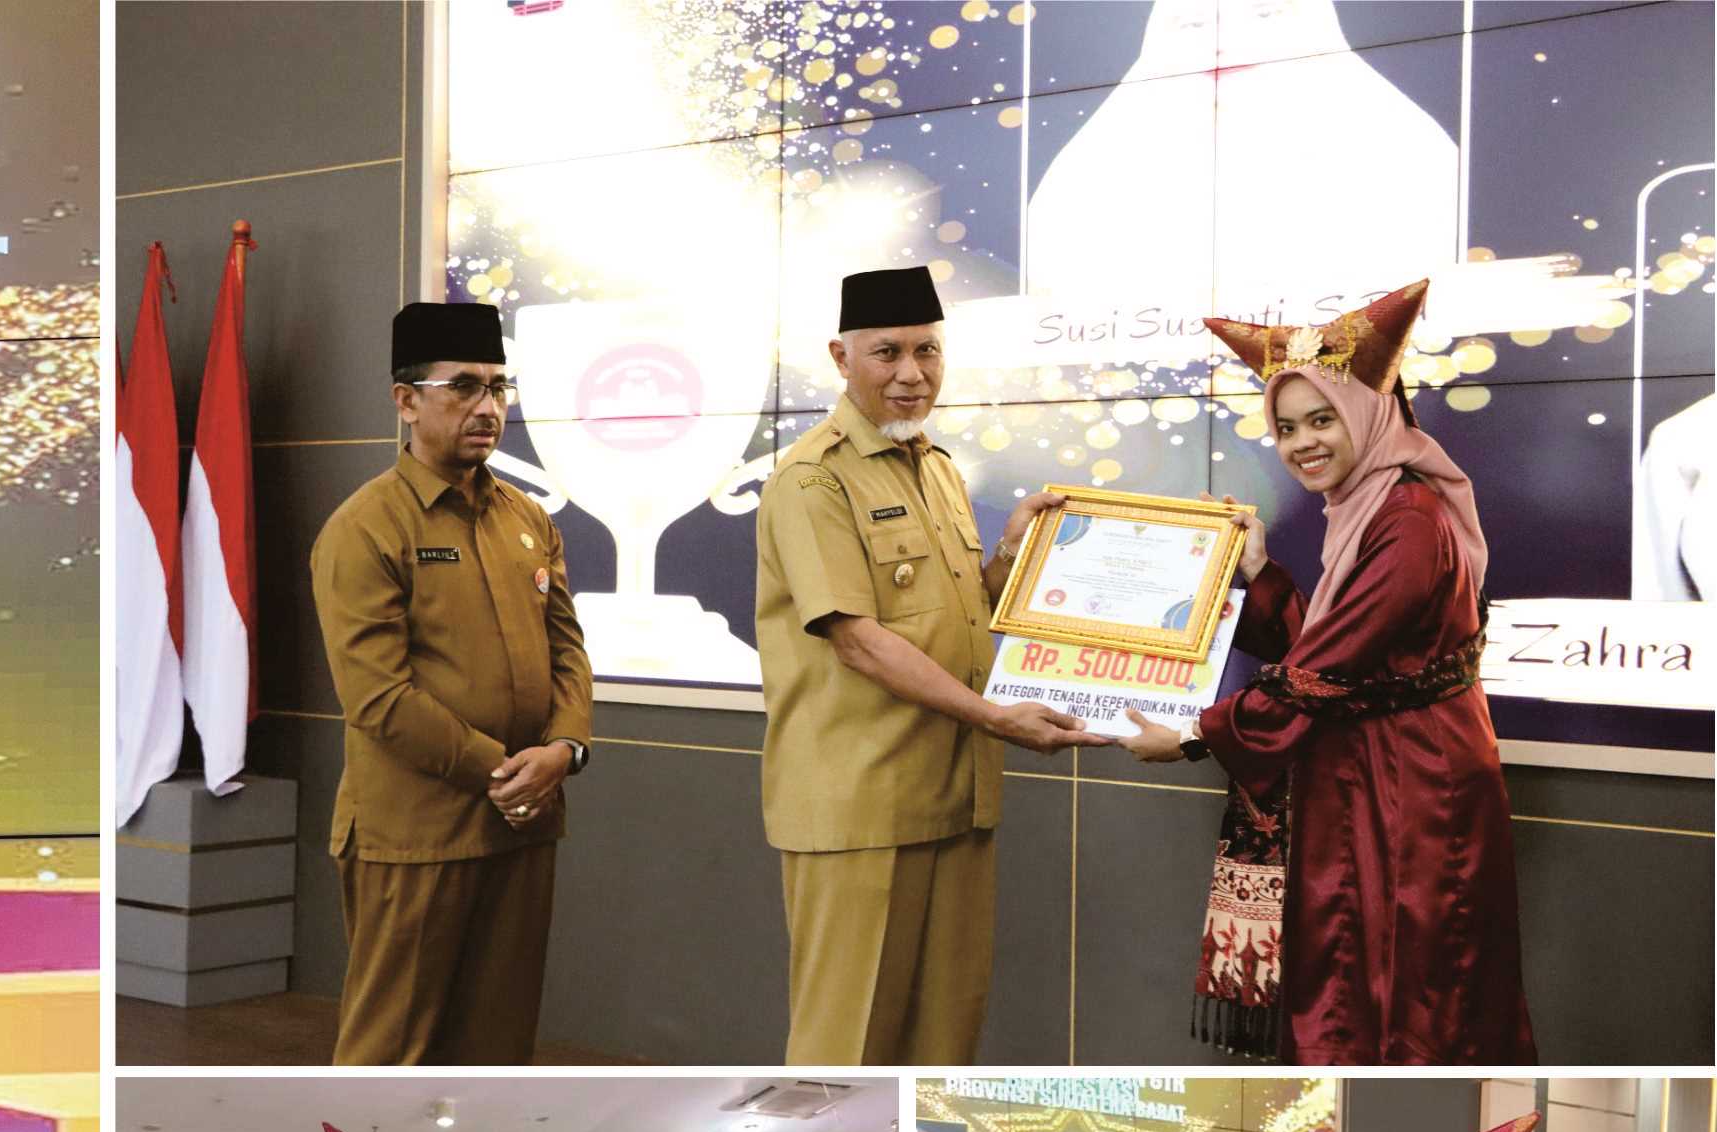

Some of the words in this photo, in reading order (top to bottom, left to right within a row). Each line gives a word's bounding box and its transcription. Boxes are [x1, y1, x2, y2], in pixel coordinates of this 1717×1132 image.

[1033, 310, 1118, 345] Susi
[1508, 623, 1692, 671] Zahra
[991, 683, 1044, 700] KATEGORI
[1047, 688, 1091, 704] TENAGA
[1094, 695, 1176, 715] KEPENDIDIKAN
[1066, 703, 1118, 721] INOVATIF
